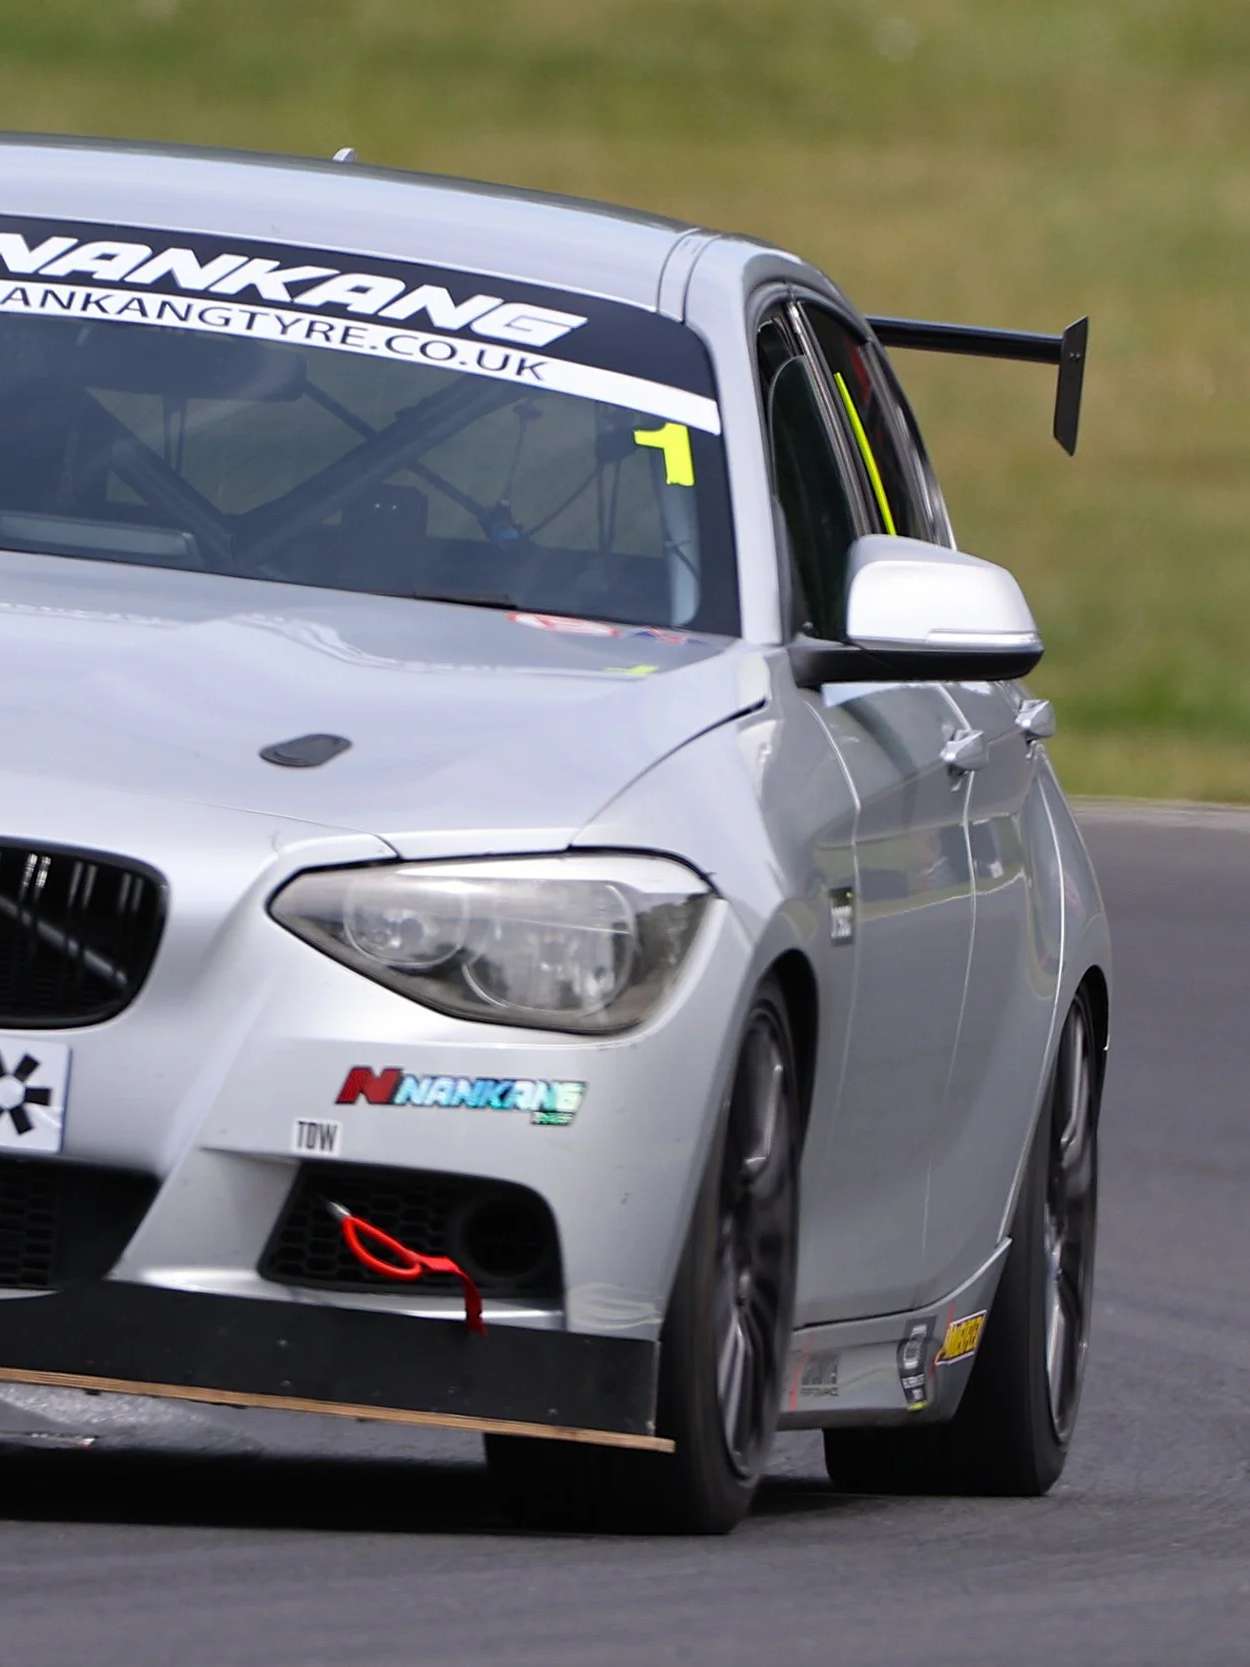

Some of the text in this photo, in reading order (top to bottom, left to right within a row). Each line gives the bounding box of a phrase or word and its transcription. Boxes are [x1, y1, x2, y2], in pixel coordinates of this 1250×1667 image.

[633, 422, 696, 488] 1
[393, 1074, 588, 1113] NANKANG
[297, 1120, 339, 1152] TOW
